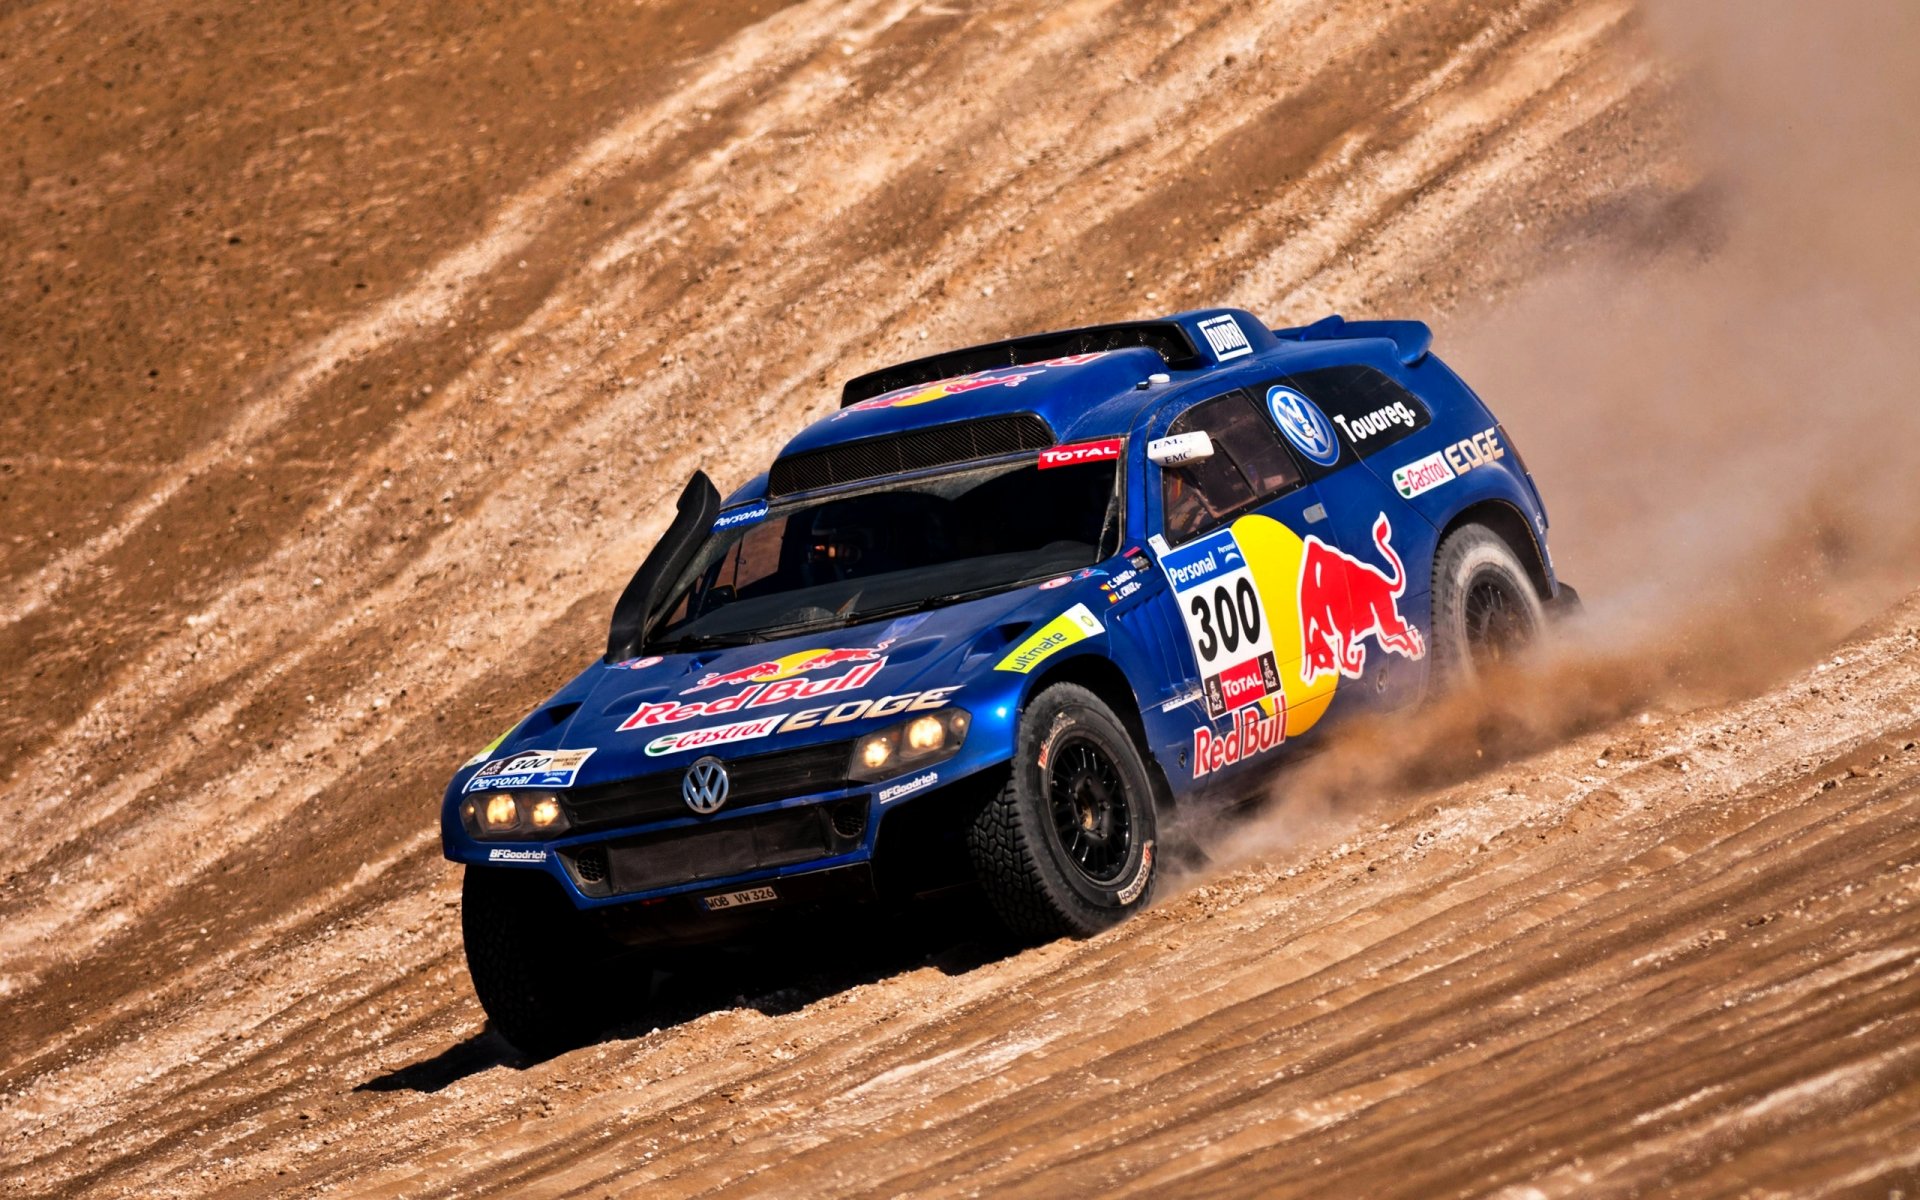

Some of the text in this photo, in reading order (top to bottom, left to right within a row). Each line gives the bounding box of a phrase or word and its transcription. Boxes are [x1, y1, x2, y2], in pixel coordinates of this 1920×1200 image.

[1041, 446, 1118, 463] TOTAL
[1406, 427, 1504, 491] Castrol EDGE
[713, 506, 768, 527] Personal
[1218, 540, 1237, 554] Personal
[1168, 550, 1217, 586] Personal
[1191, 576, 1261, 662] 300
[1011, 632, 1068, 671] ultimate
[616, 656, 889, 732] Red Bull
[1221, 672, 1264, 699] TOTAL
[675, 685, 967, 748] Castrol EDGE
[1193, 691, 1287, 779] Red Bull
[507, 757, 552, 771] 300
[469, 773, 535, 789] Personal
[878, 771, 939, 802] BFGoodrich
[489, 848, 548, 860] BFGoodrich
[705, 887, 775, 909] WOB VW 326
